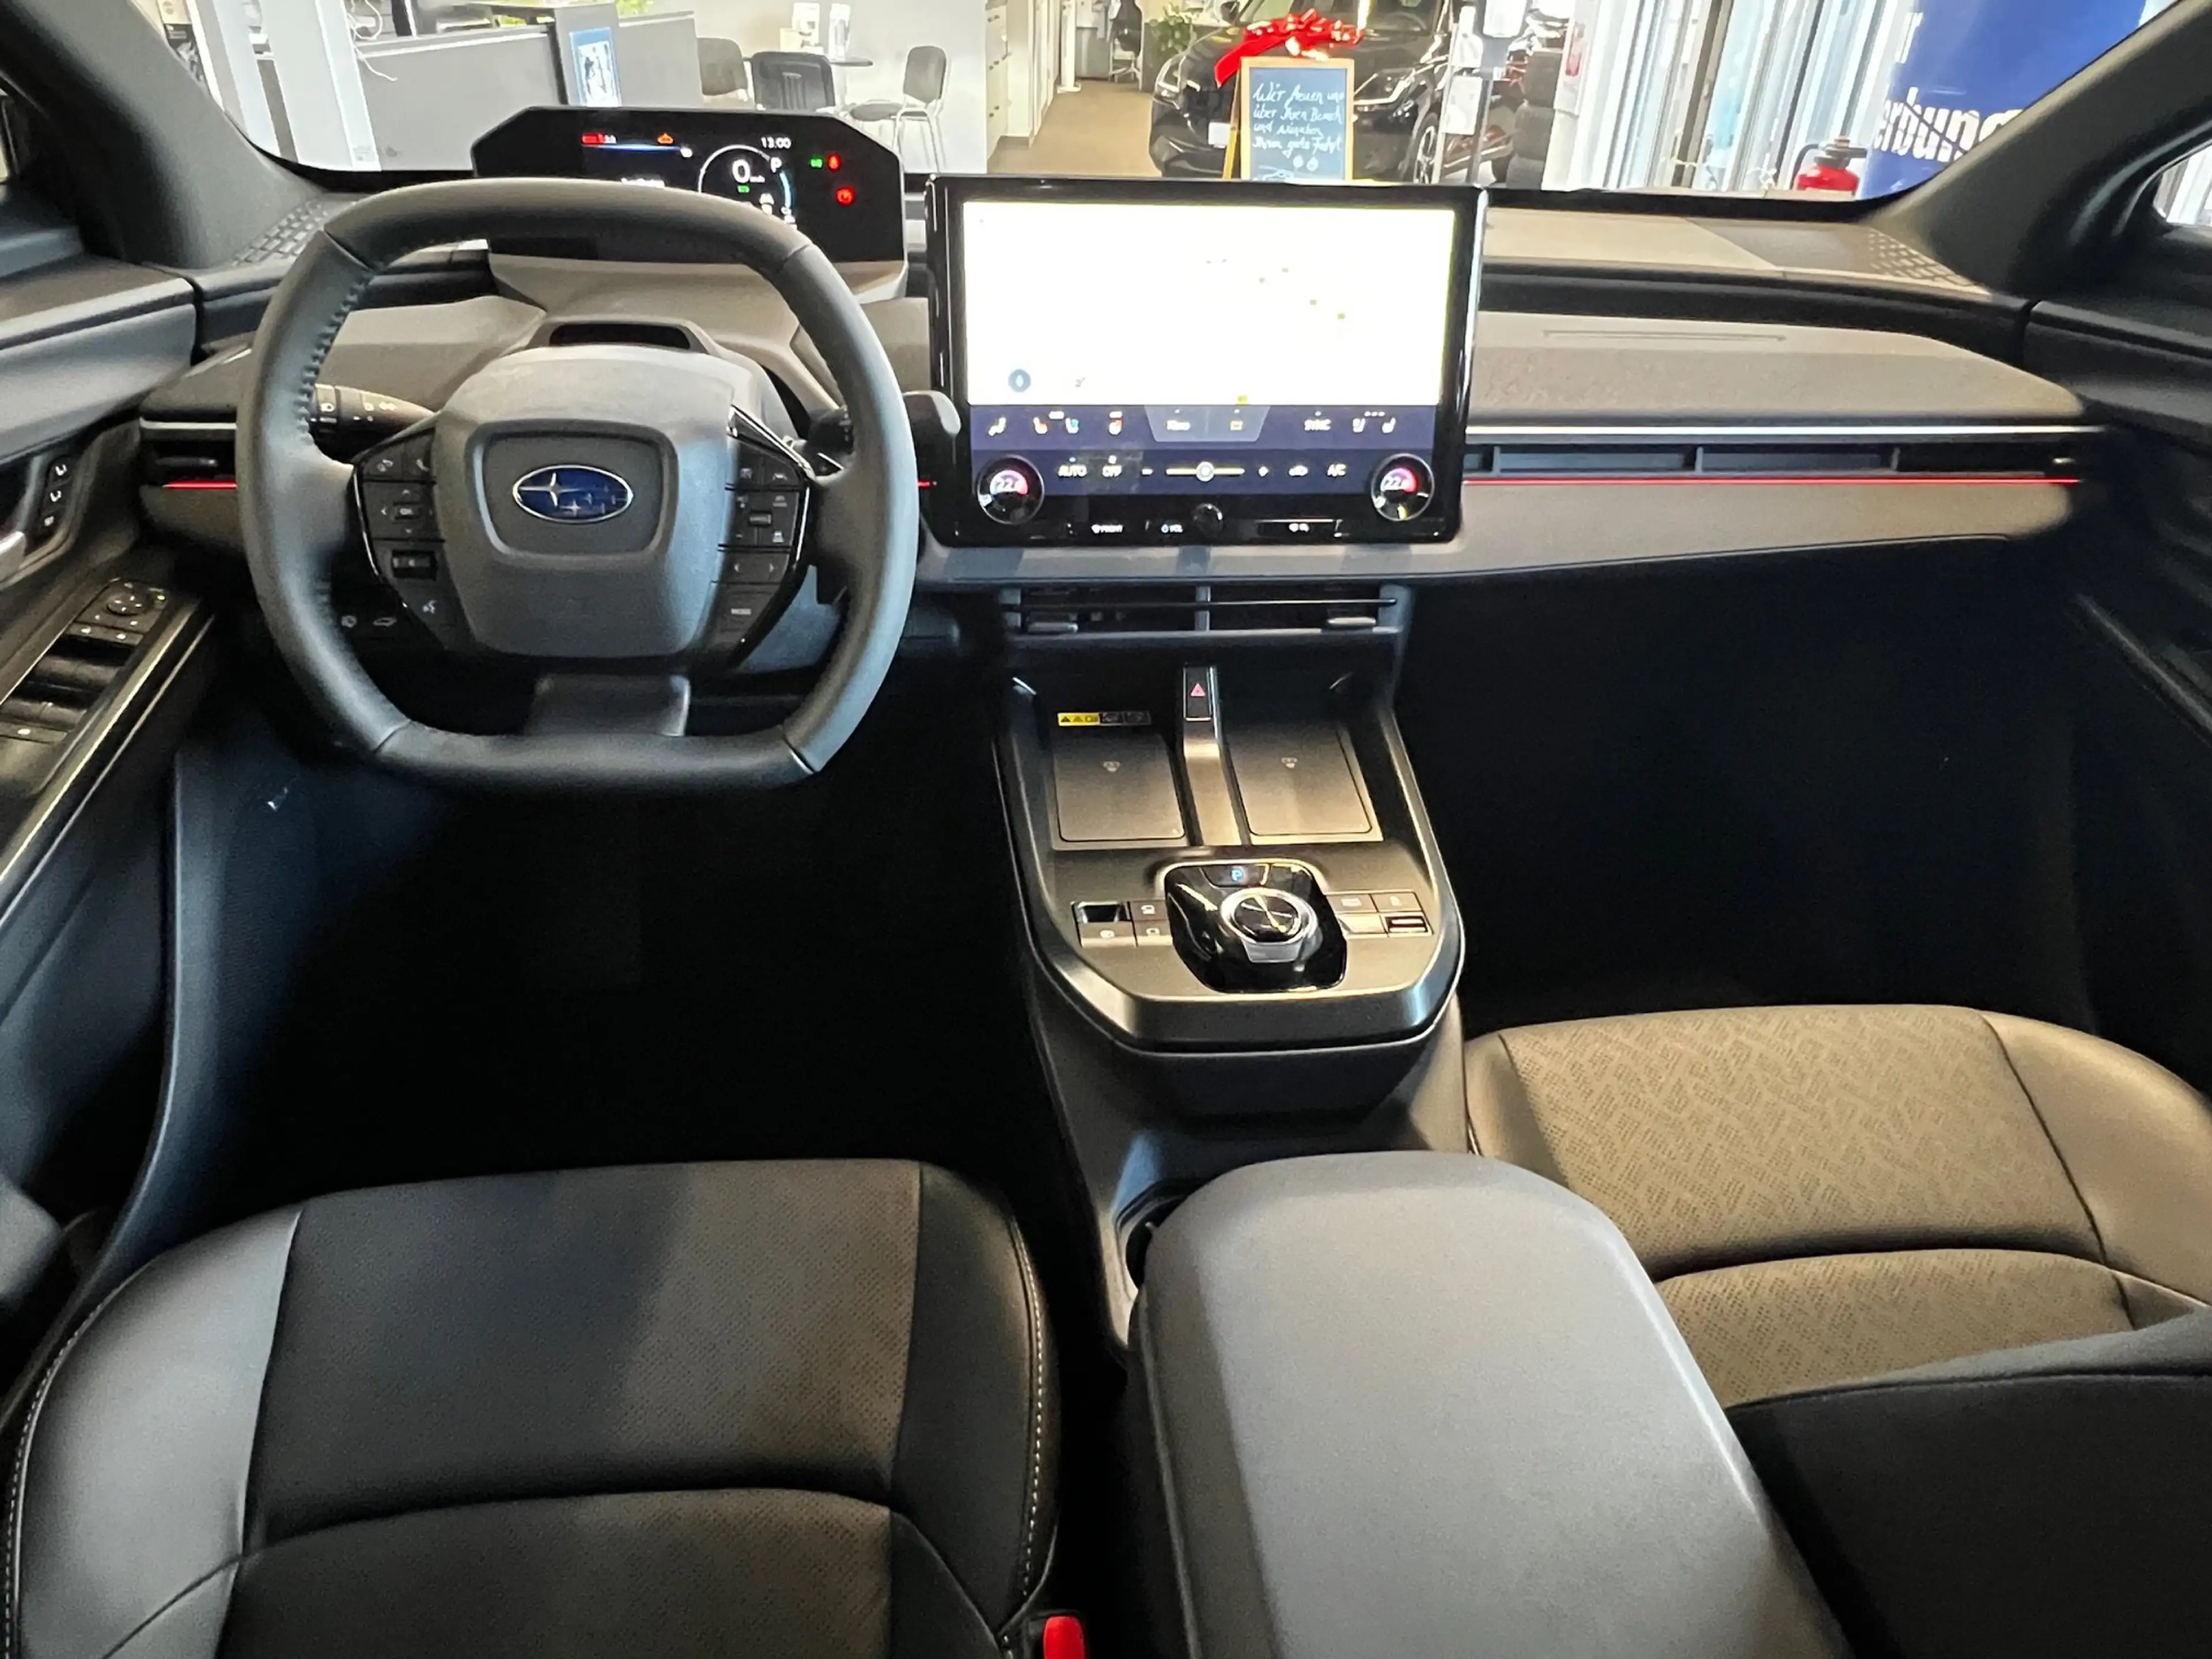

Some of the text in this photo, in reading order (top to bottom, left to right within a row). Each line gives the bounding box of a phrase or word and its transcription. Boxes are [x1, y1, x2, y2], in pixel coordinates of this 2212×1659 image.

[1253, 81, 1286, 102] Wir
[1253, 103, 1277, 119] über
[1253, 120, 1273, 133] und
[732, 158, 750, 184] 0
[1058, 464, 1088, 478] AUTO
[1102, 464, 1123, 478] OFF
[1327, 463, 1347, 477] A/C
[1231, 869, 1243, 881] P
